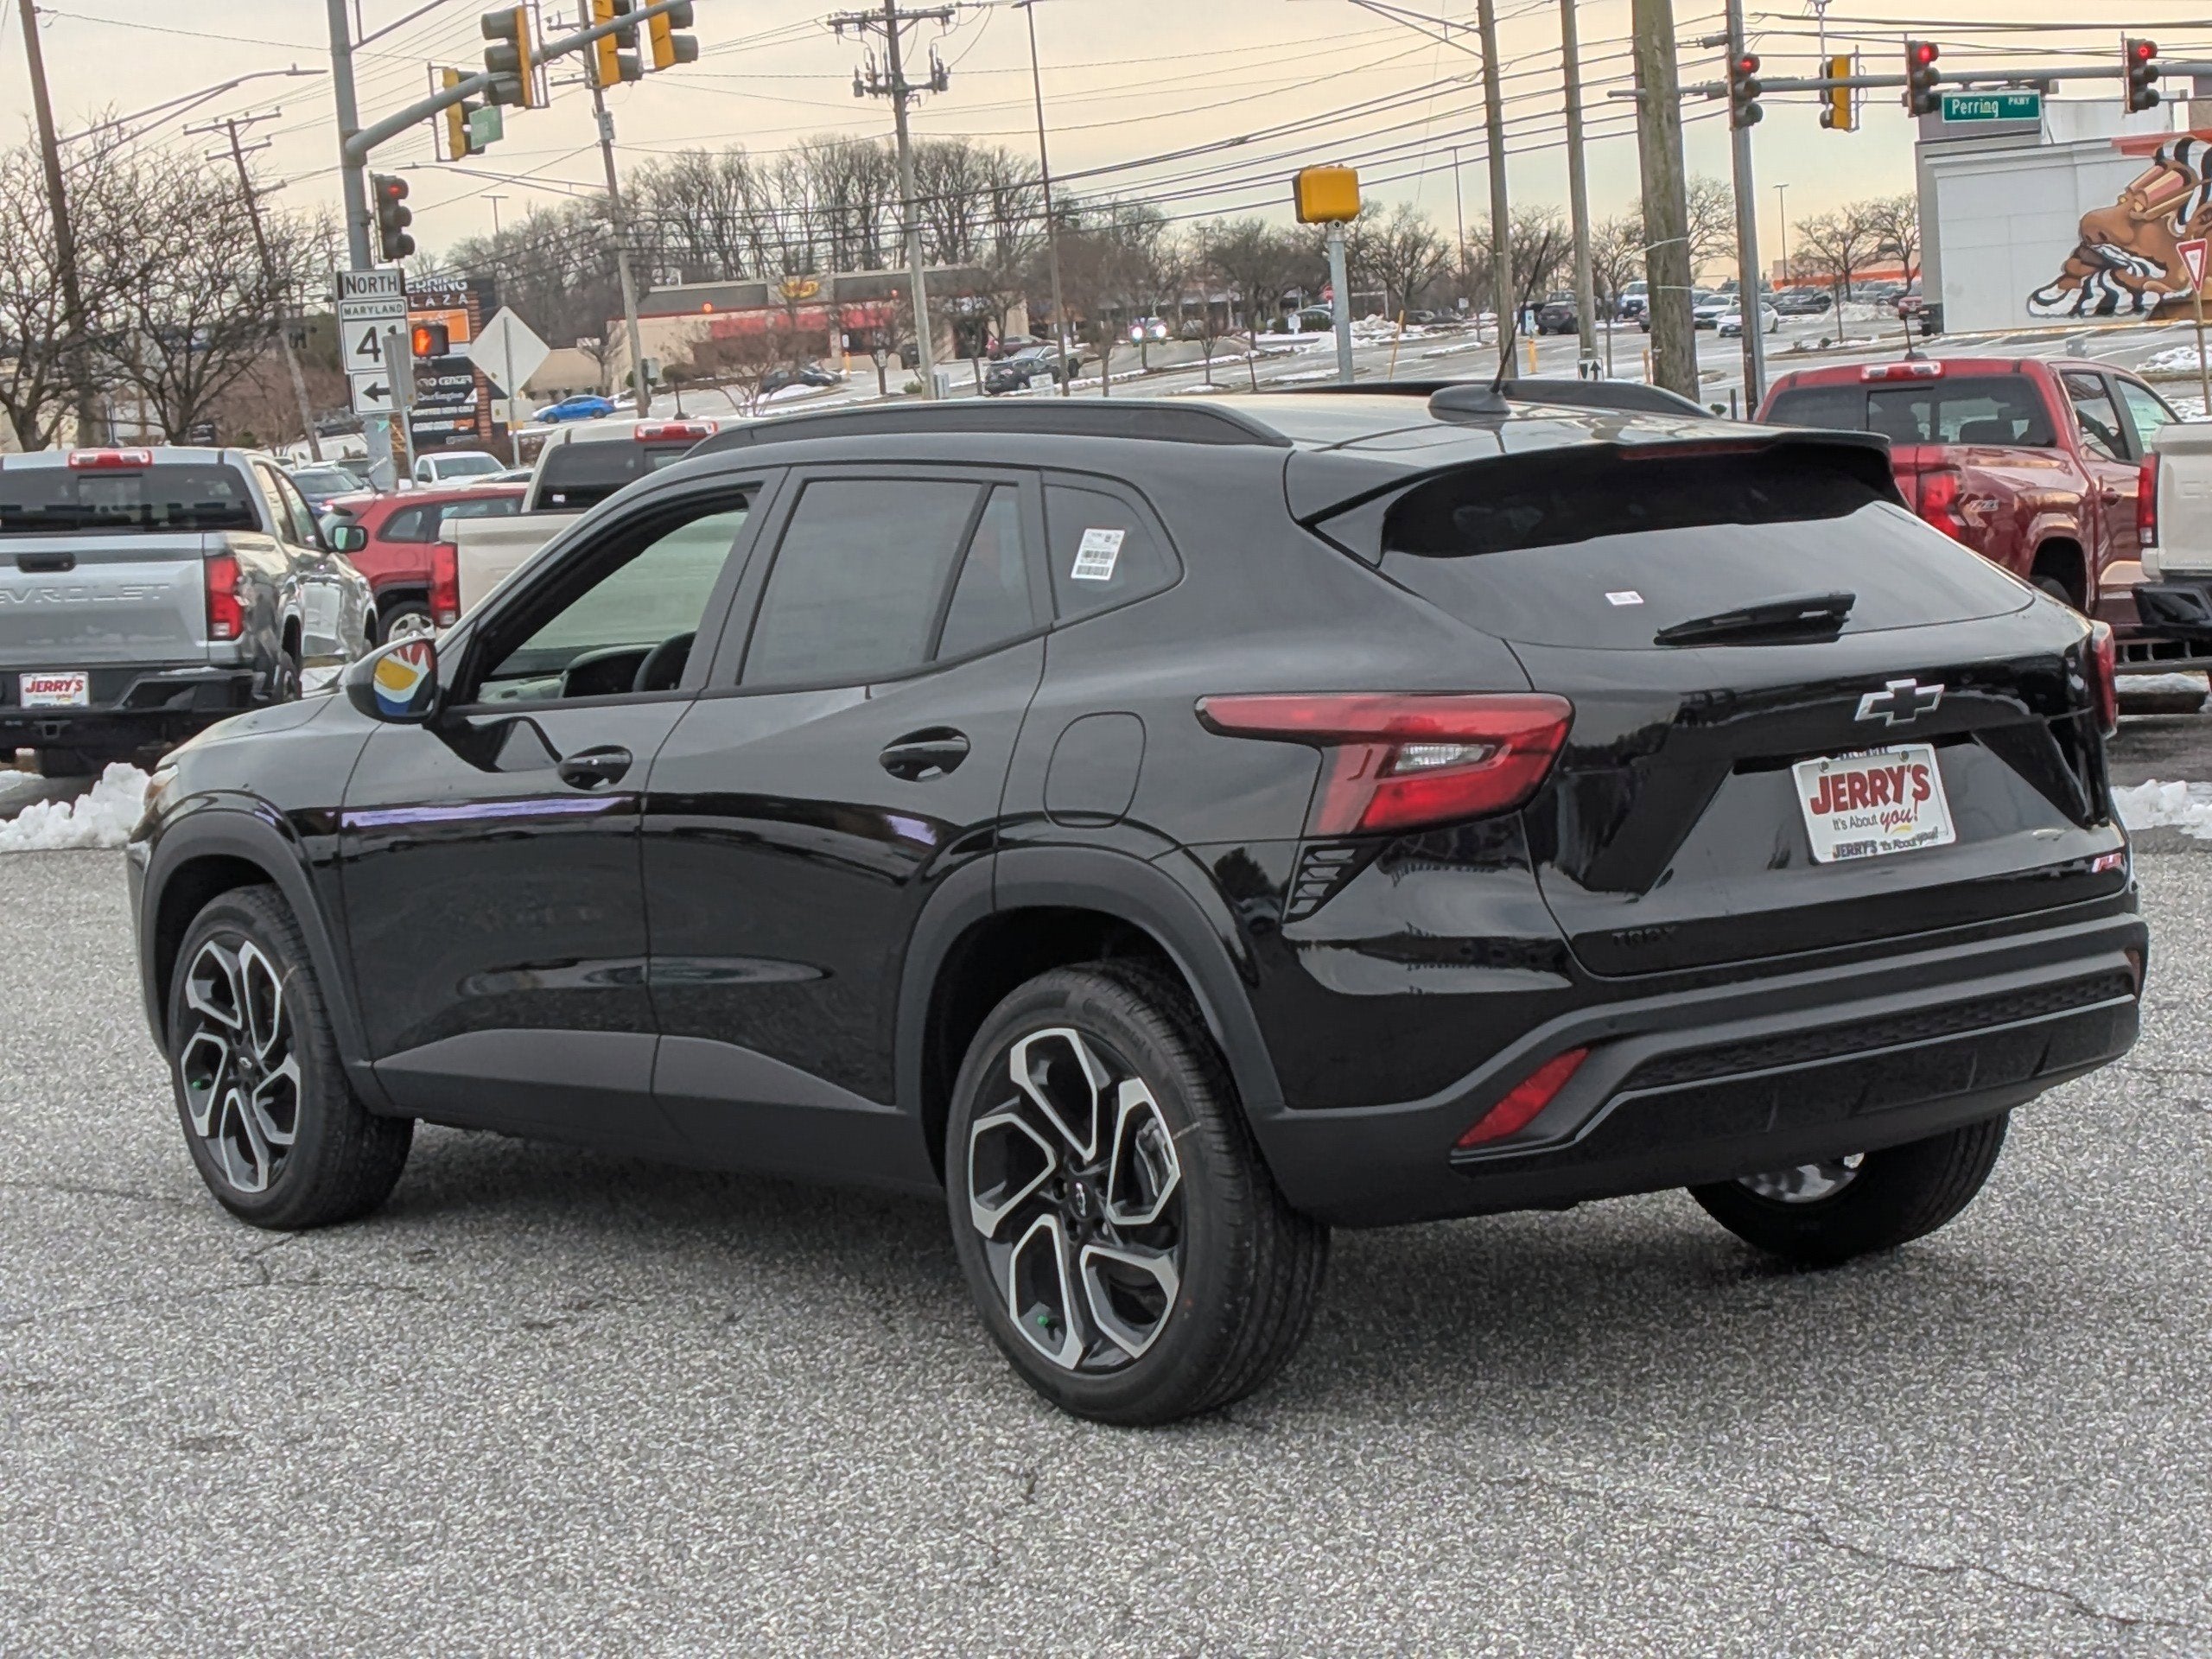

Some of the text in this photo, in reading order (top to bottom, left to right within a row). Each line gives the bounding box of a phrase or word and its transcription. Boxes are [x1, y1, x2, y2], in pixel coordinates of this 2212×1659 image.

[1952, 99, 1999, 118] Perring
[346, 275, 397, 295] NORTH
[405, 276, 468, 294] ERRING
[344, 303, 404, 315] MARYLAND
[410, 293, 469, 308] LAZA
[356, 325, 397, 363] 4
[25, 679, 84, 694] JERRY'S
[1810, 764, 1931, 816] JERRY'S
[1833, 818, 1848, 831] It's
[1849, 815, 1878, 830] About
[1832, 840, 1878, 859] JERRY'S
[1892, 837, 1916, 850] About
